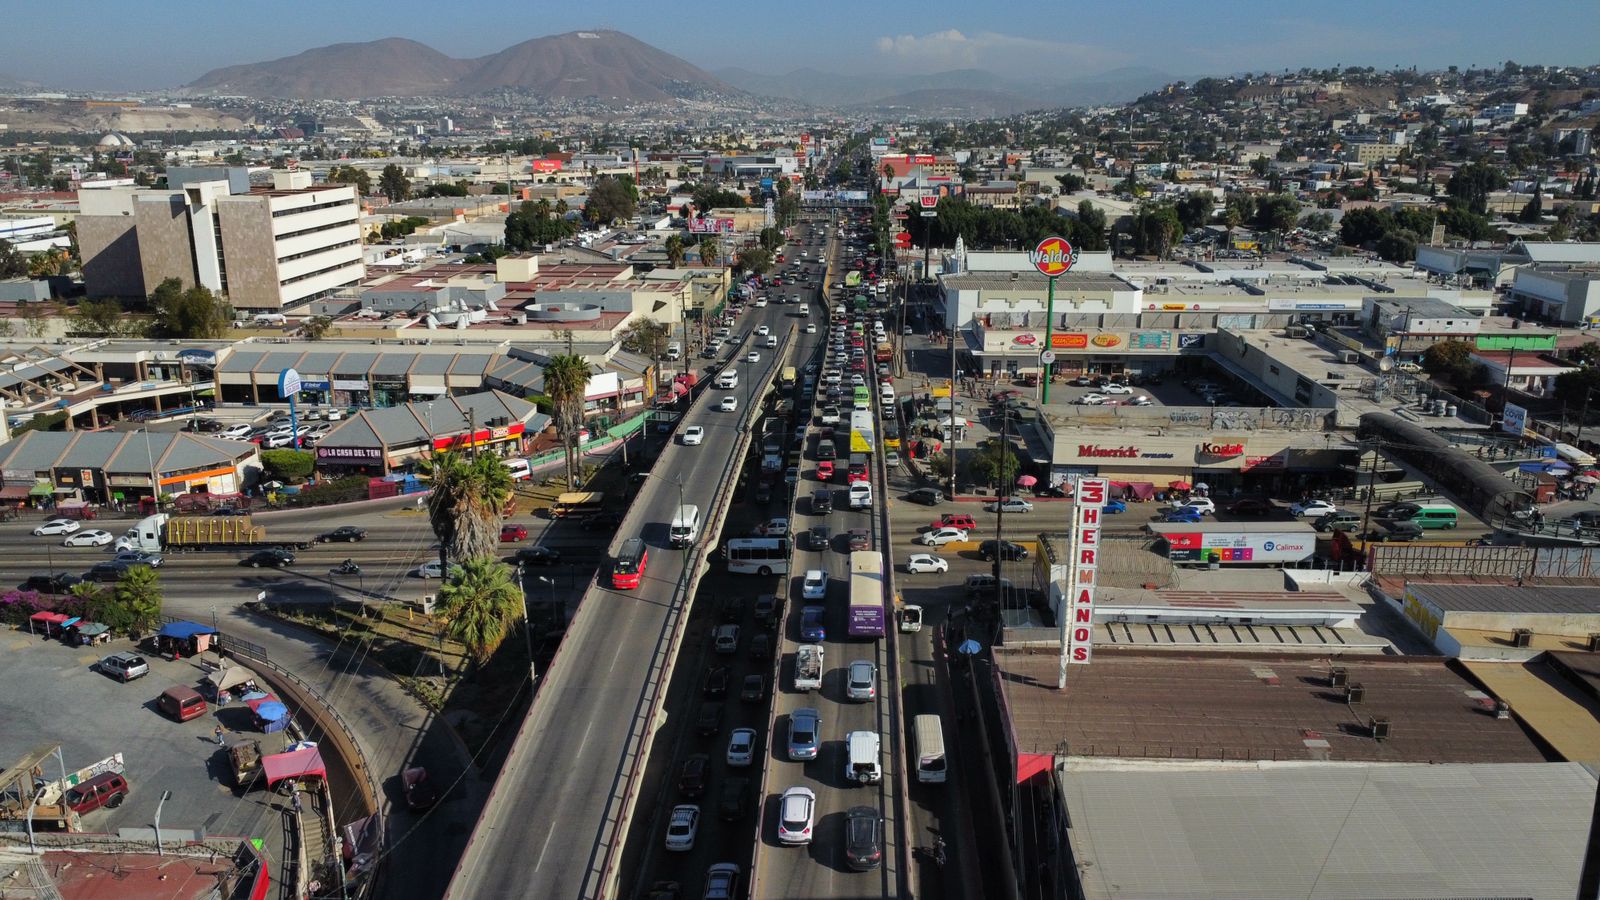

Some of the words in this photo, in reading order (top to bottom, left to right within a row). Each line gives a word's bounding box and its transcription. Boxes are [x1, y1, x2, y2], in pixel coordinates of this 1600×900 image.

[1029, 249, 1078, 263] Waldo's
[327, 448, 335, 457] LA
[336, 448, 353, 457] CASA
[353, 448, 366, 457] DEL
[1202, 442, 1244, 454] Kodak
[1081, 486, 1104, 503] 3
[1275, 543, 1304, 551] Calimax
[1073, 509, 1098, 661] HERMANOS
